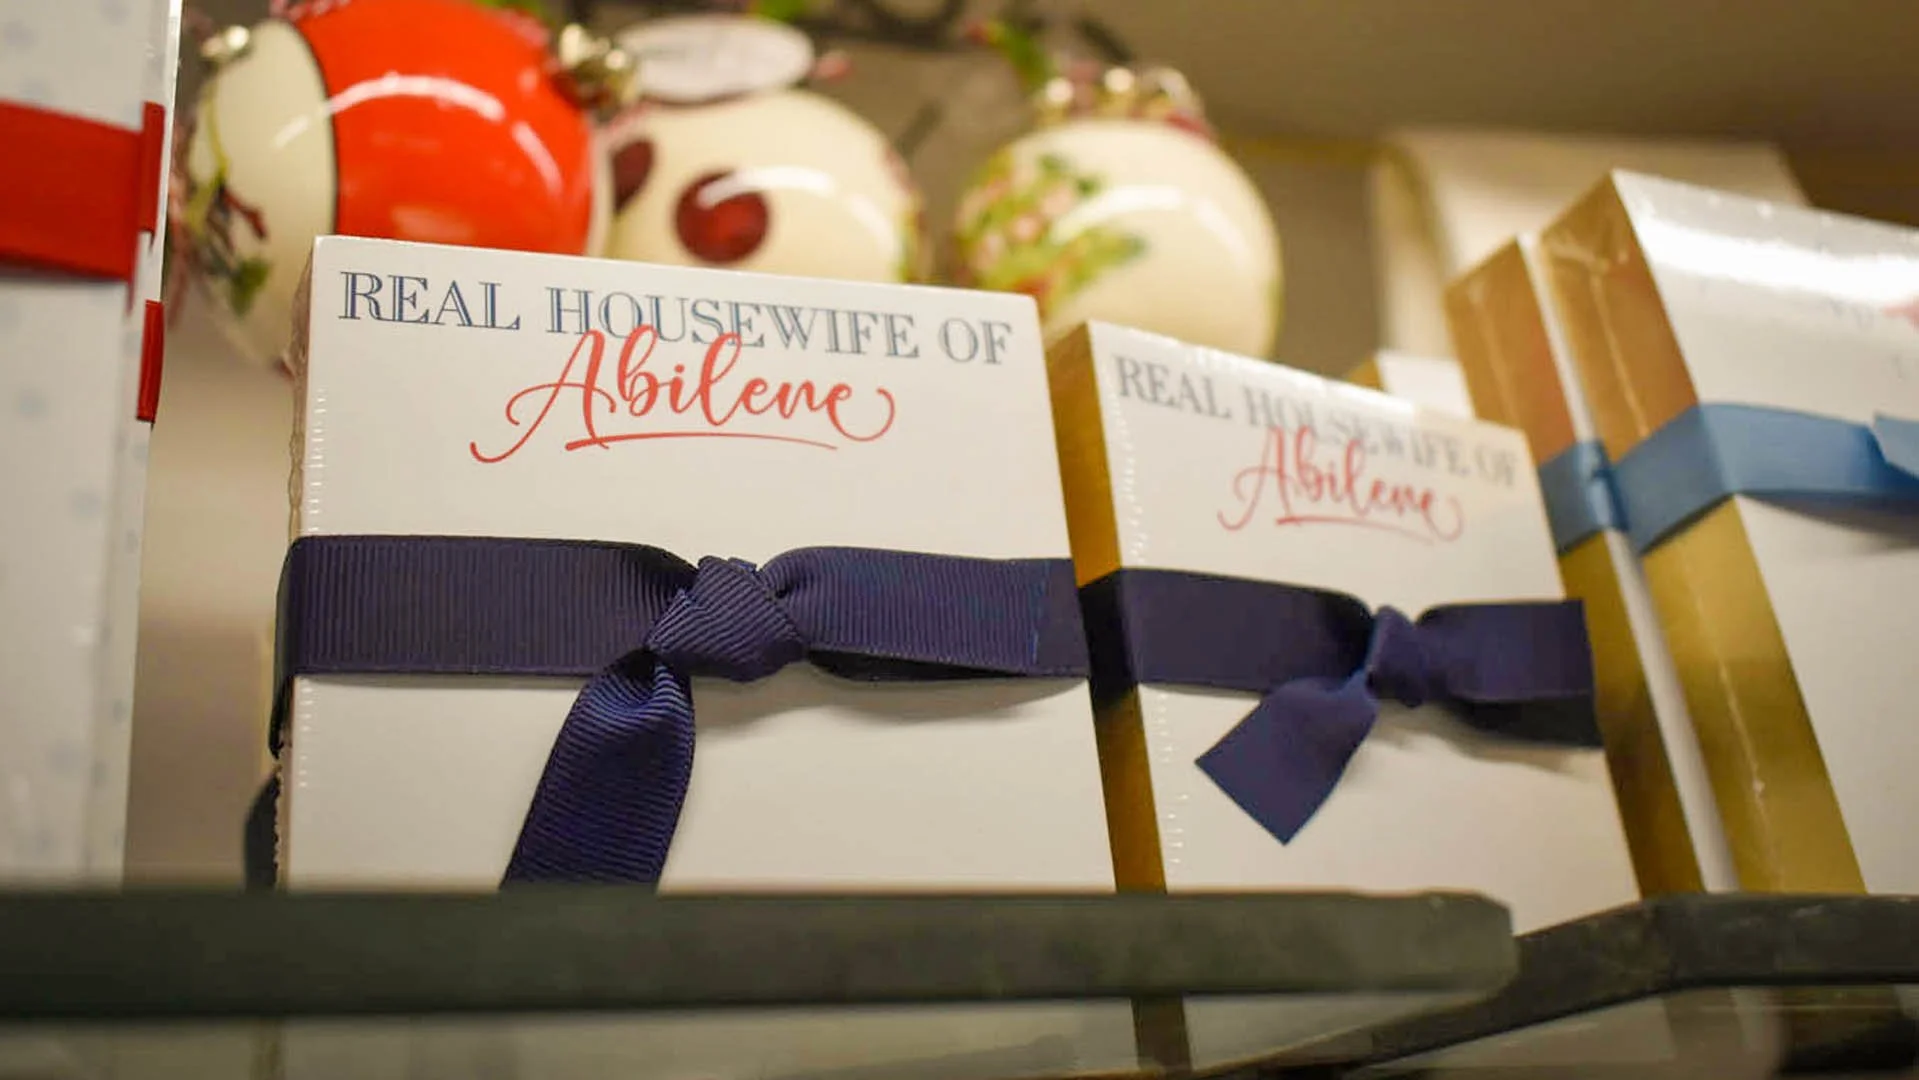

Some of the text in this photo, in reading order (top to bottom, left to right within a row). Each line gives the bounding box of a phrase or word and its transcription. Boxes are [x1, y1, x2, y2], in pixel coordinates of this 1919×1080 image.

[338, 271, 1013, 366] REAL HOUSEWIFE OF
[470, 324, 896, 463] Abilene
[1114, 355, 1521, 488] REAL HOUSEWIFE OF
[1217, 425, 1464, 545] Abilene
